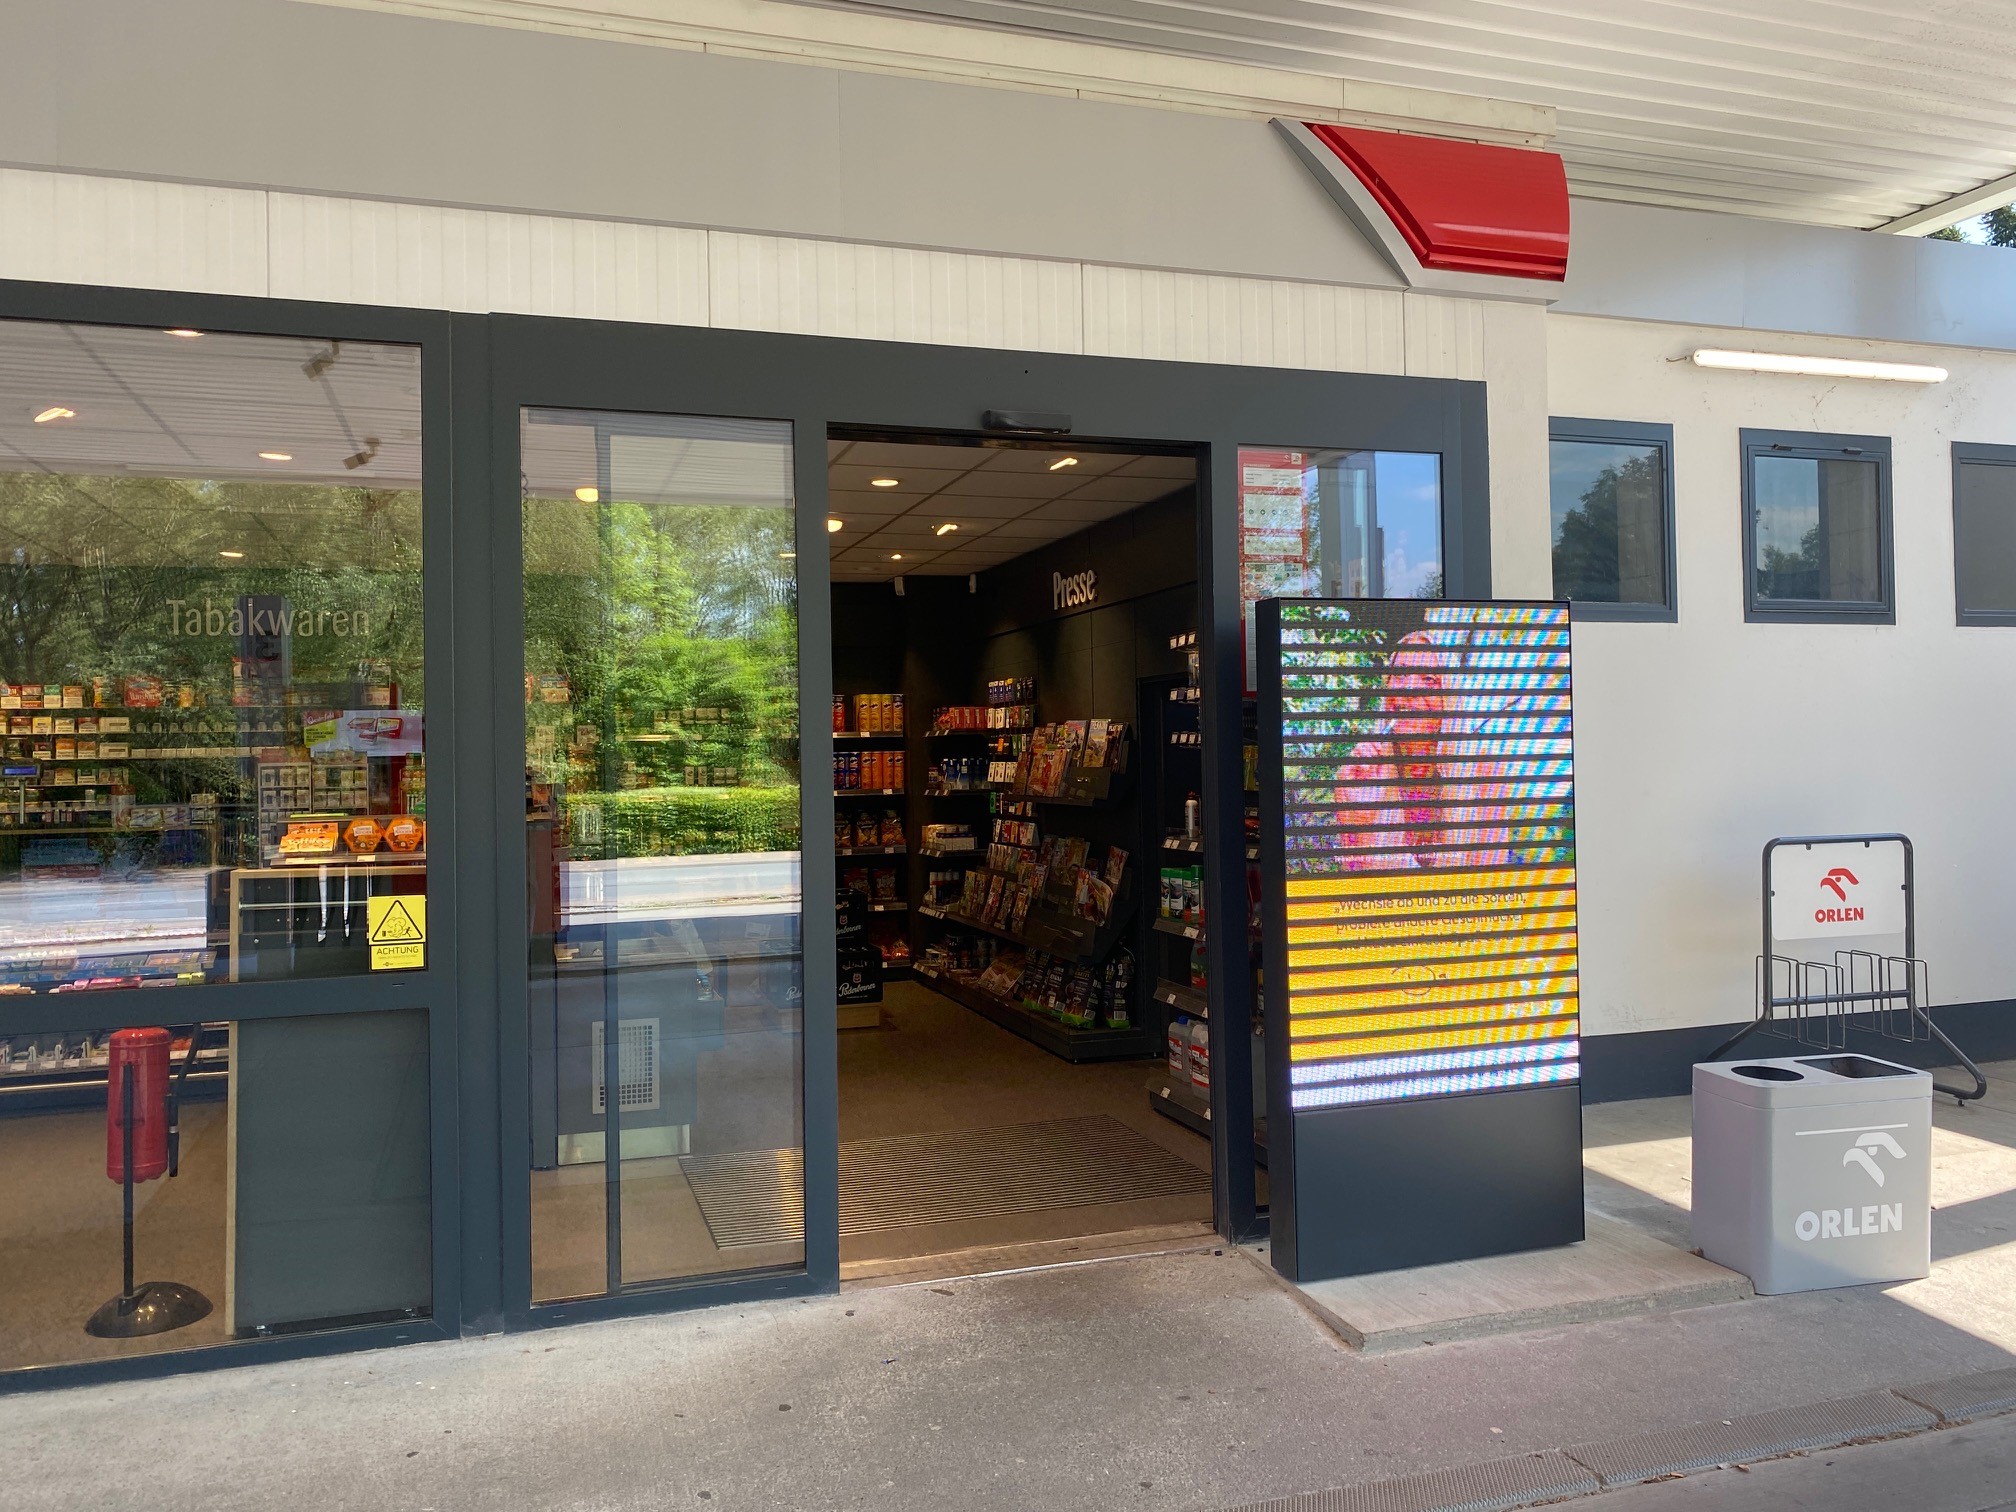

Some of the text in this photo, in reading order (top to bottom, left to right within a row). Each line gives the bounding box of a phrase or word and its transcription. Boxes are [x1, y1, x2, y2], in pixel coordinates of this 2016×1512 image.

[1053, 570, 1096, 610] Presse
[165, 598, 370, 637] Tabakwaren
[1815, 907, 1864, 923] ORLEN
[376, 945, 419, 955] ACHTUNG
[1794, 1202, 1903, 1241] ORLEN
